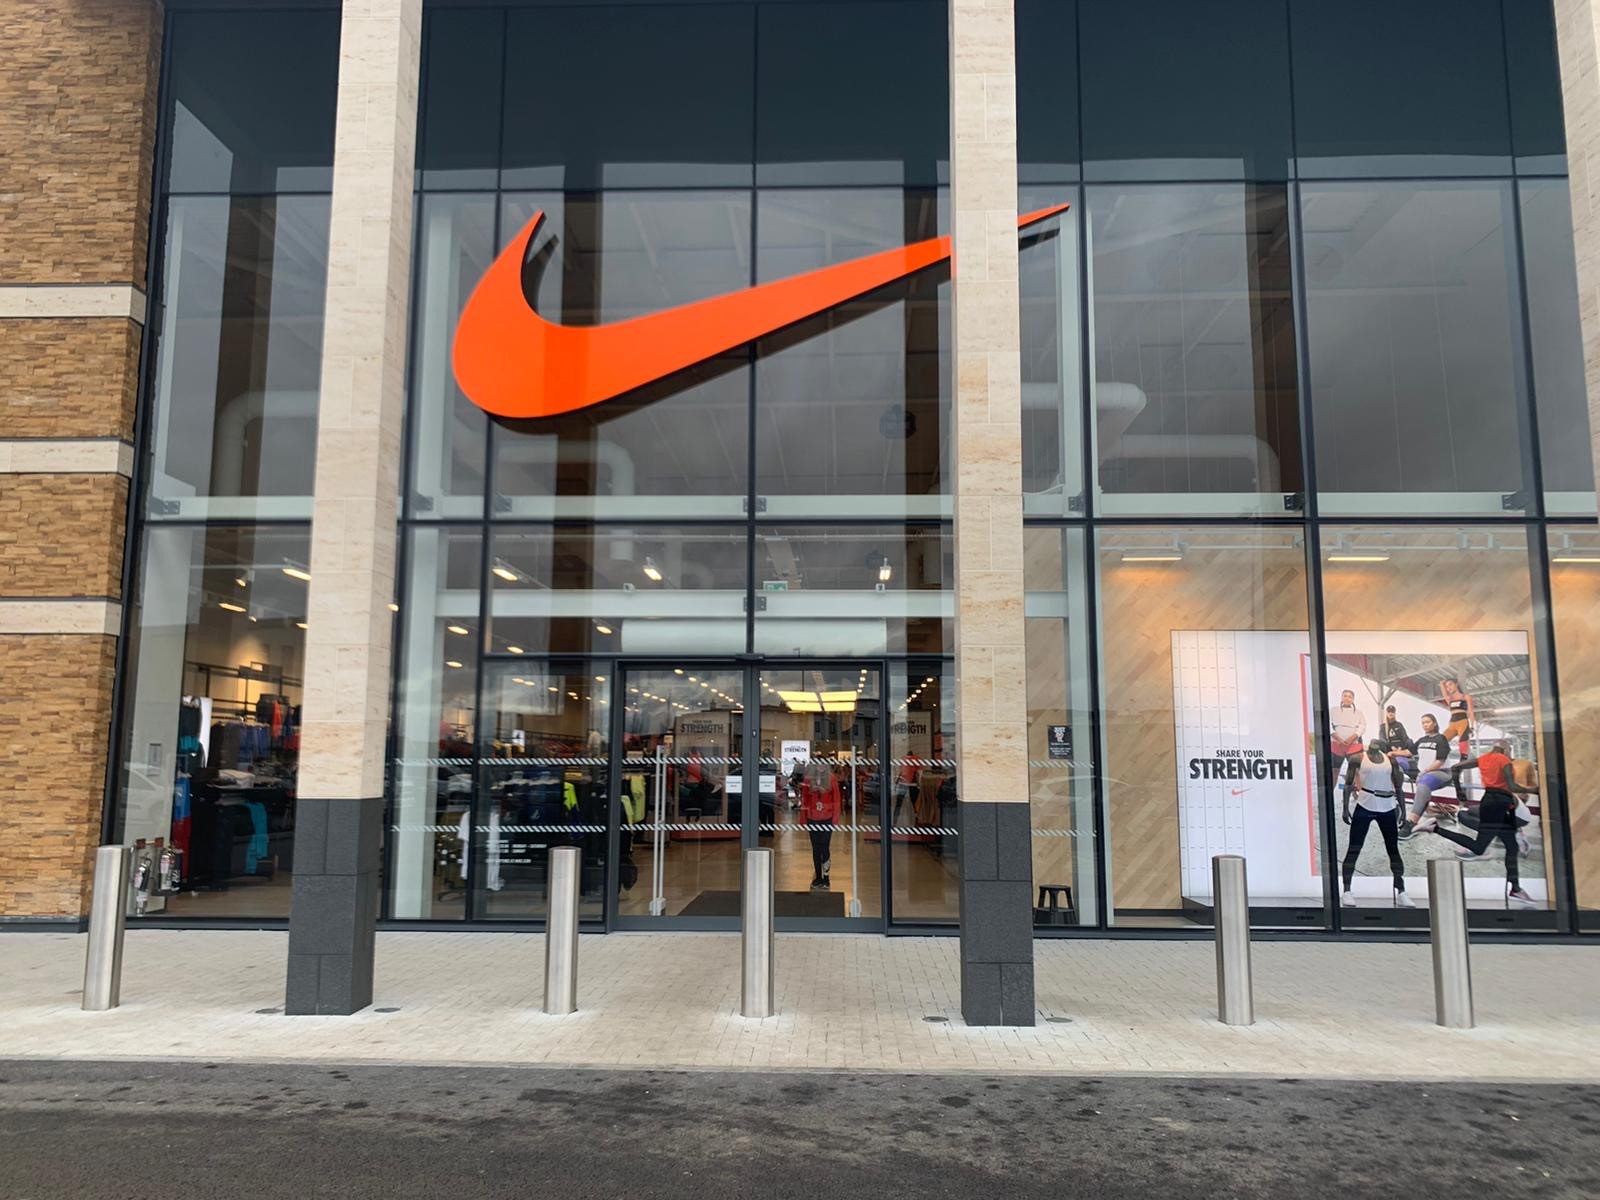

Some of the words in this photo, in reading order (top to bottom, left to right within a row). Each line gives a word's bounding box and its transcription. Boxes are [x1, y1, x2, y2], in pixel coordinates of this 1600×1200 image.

[681, 723, 724, 733] STRENGTH
[890, 722, 927, 734] TRENGTH
[1189, 758, 1293, 780] STRENGTH
